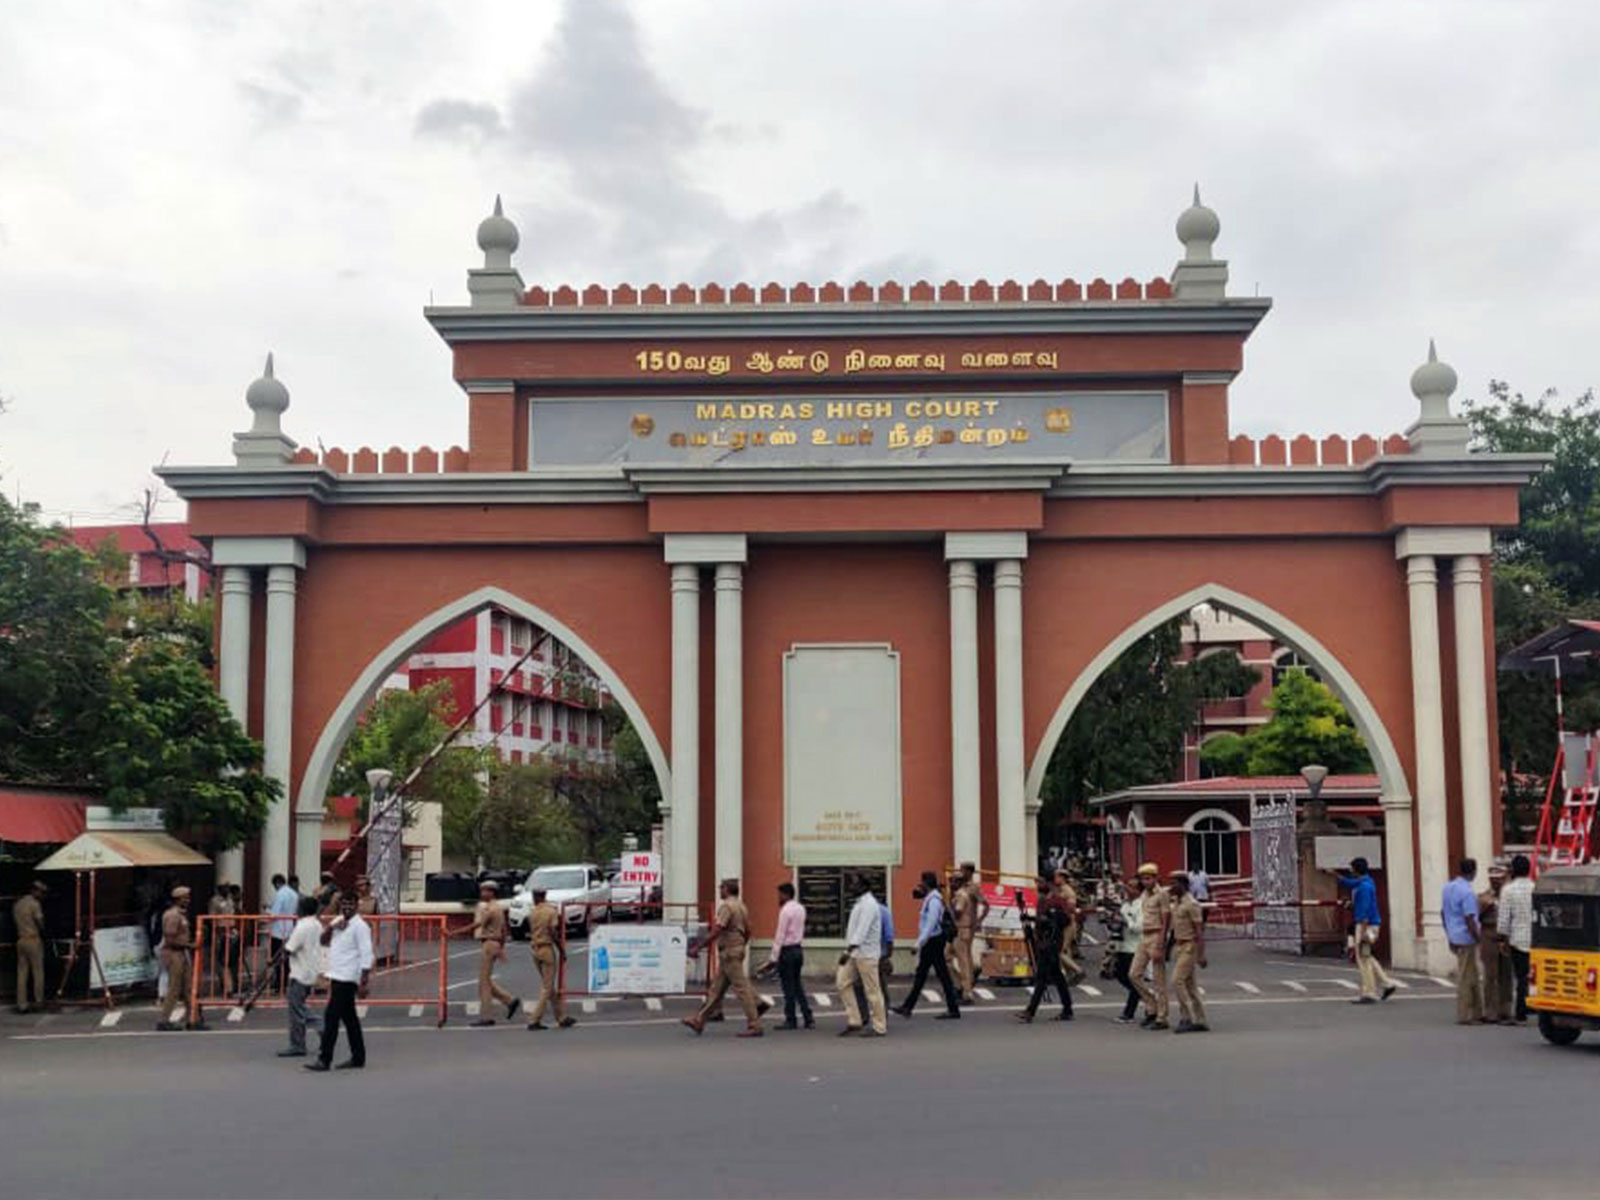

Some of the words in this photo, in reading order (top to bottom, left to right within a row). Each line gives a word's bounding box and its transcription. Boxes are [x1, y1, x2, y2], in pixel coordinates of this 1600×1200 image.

[635, 350, 731, 375] 150வது
[746, 349, 829, 374] ஆண்டு
[844, 349, 946, 373] நினைவு
[961, 351, 1058, 369] வளைவு
[696, 402, 814, 419] MADRAS
[826, 402, 893, 418] HIGH
[905, 400, 999, 417] COURT
[633, 855, 650, 866] NO
[623, 871, 657, 882] ENTRY
